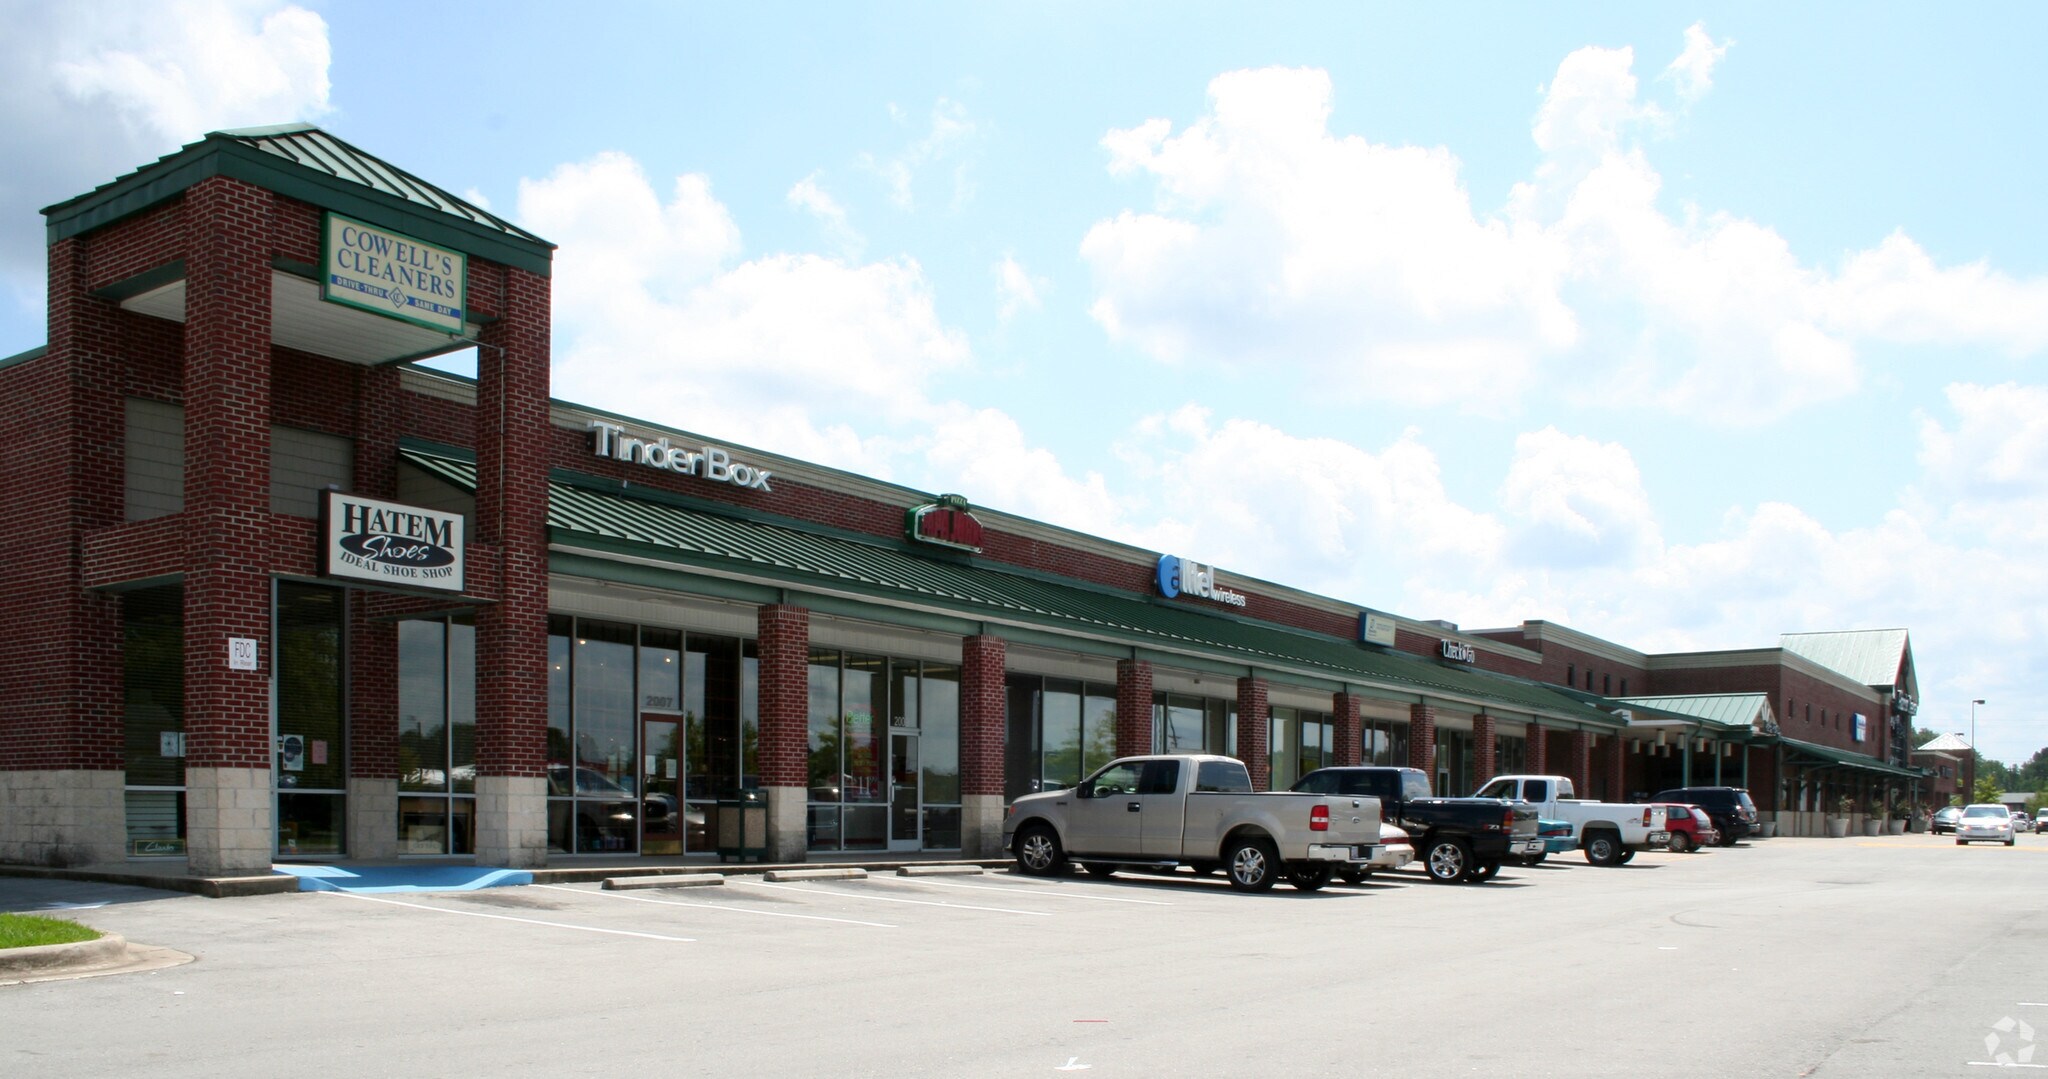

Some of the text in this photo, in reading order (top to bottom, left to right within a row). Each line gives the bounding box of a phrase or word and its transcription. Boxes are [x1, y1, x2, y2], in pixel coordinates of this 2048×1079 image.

[342, 226, 452, 276] COWELL'S
[337, 248, 455, 299] CLEANERS
[337, 277, 384, 297] DRIVE-THRU
[414, 299, 452, 315] SAME DAY
[342, 502, 455, 549] HATEM
[362, 535, 430, 561] Shoes
[340, 551, 453, 579] IDEAL SHOE SHOP
[1213, 587, 1246, 607] wireless
[235, 641, 251, 658] FDC
